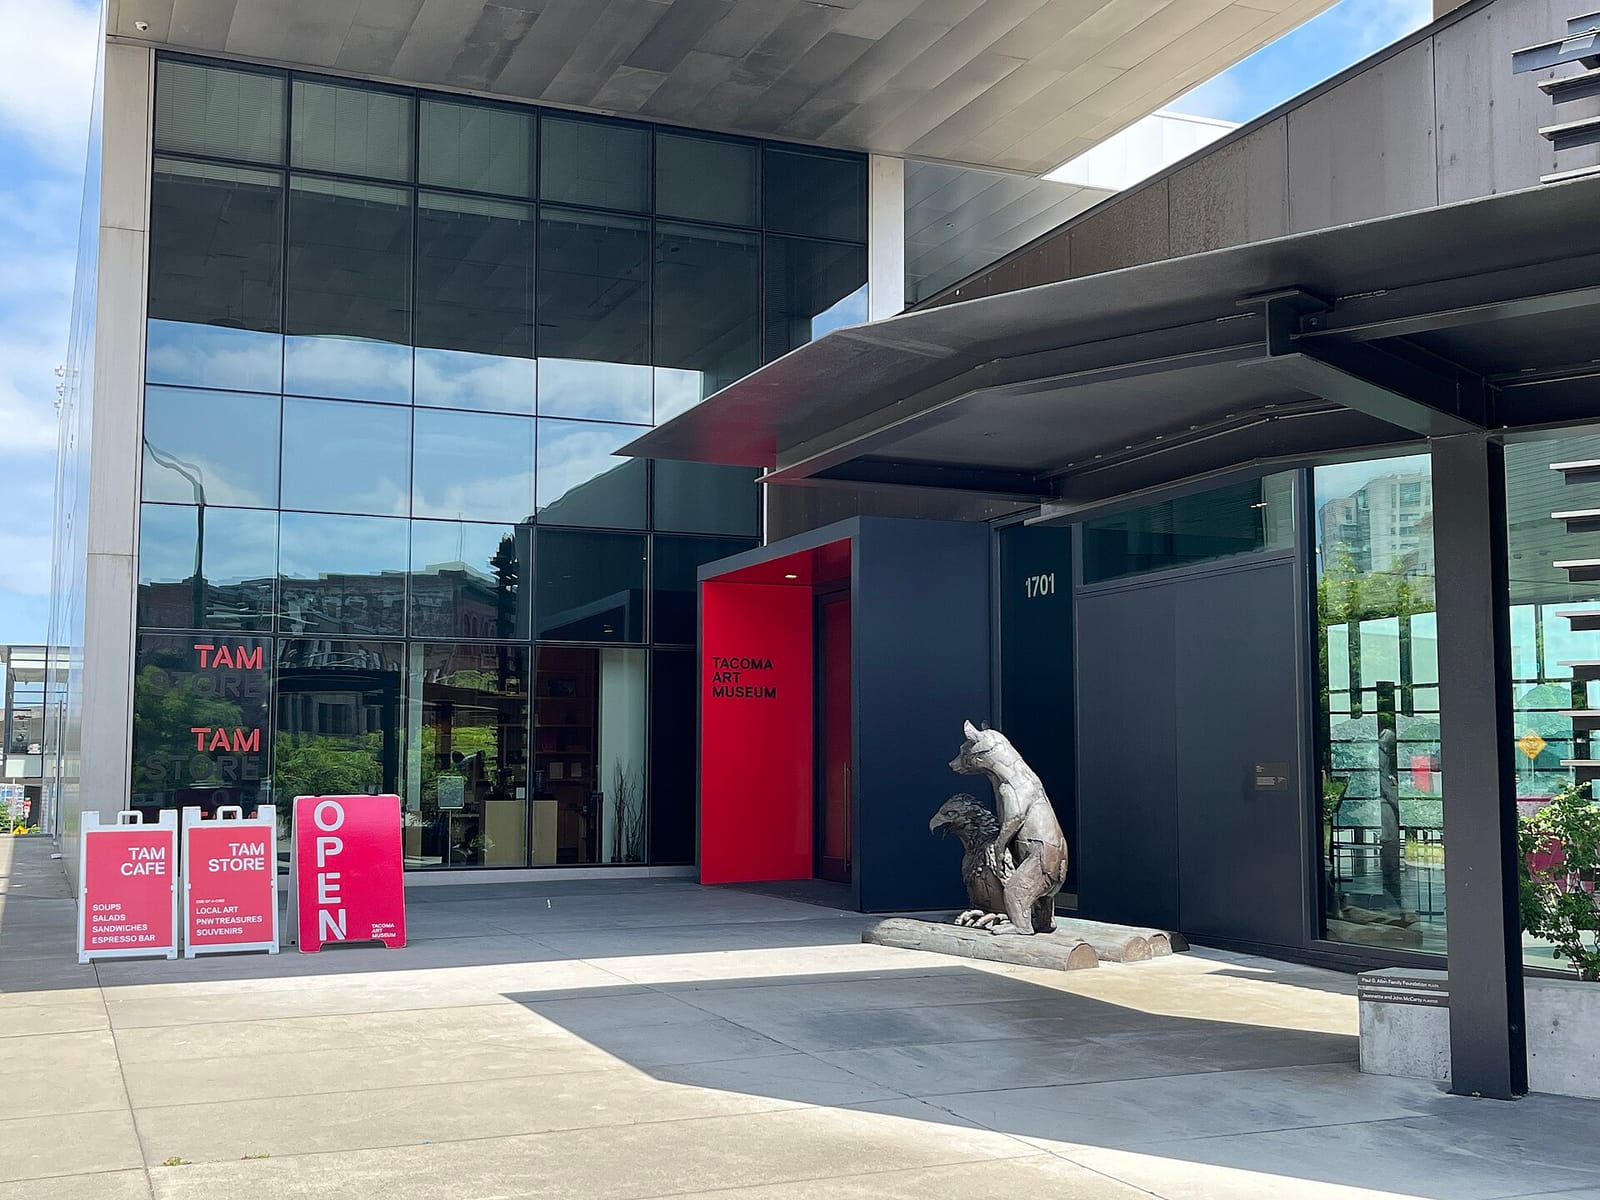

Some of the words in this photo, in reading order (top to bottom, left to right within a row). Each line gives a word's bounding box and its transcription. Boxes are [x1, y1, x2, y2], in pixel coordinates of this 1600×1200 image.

[1025, 572, 1055, 598] 1701
[194, 644, 263, 669] TAM
[712, 656, 773, 670] TACOMA
[712, 672, 742, 683] ART
[712, 686, 777, 698] MUSEUM
[191, 727, 260, 752] TAM
[145, 754, 260, 780] STORE
[128, 846, 165, 860] TAM
[228, 842, 265, 857] TAM
[120, 861, 165, 876] CAFE
[208, 857, 265, 872] STORE
[313, 800, 347, 941] OPEN
[92, 903, 122, 912] SOUPS
[196, 907, 222, 915] LOCAL
[222, 905, 239, 914] ART
[92, 914, 126, 922] SALADS
[196, 917, 215, 926] PNW
[215, 915, 263, 924] TREASURES
[92, 923, 148, 933] SANDWICHES
[196, 927, 243, 937] SOUVENIRS
[92, 935, 137, 944] ESPRESSO
[138, 934, 156, 942] BAR
